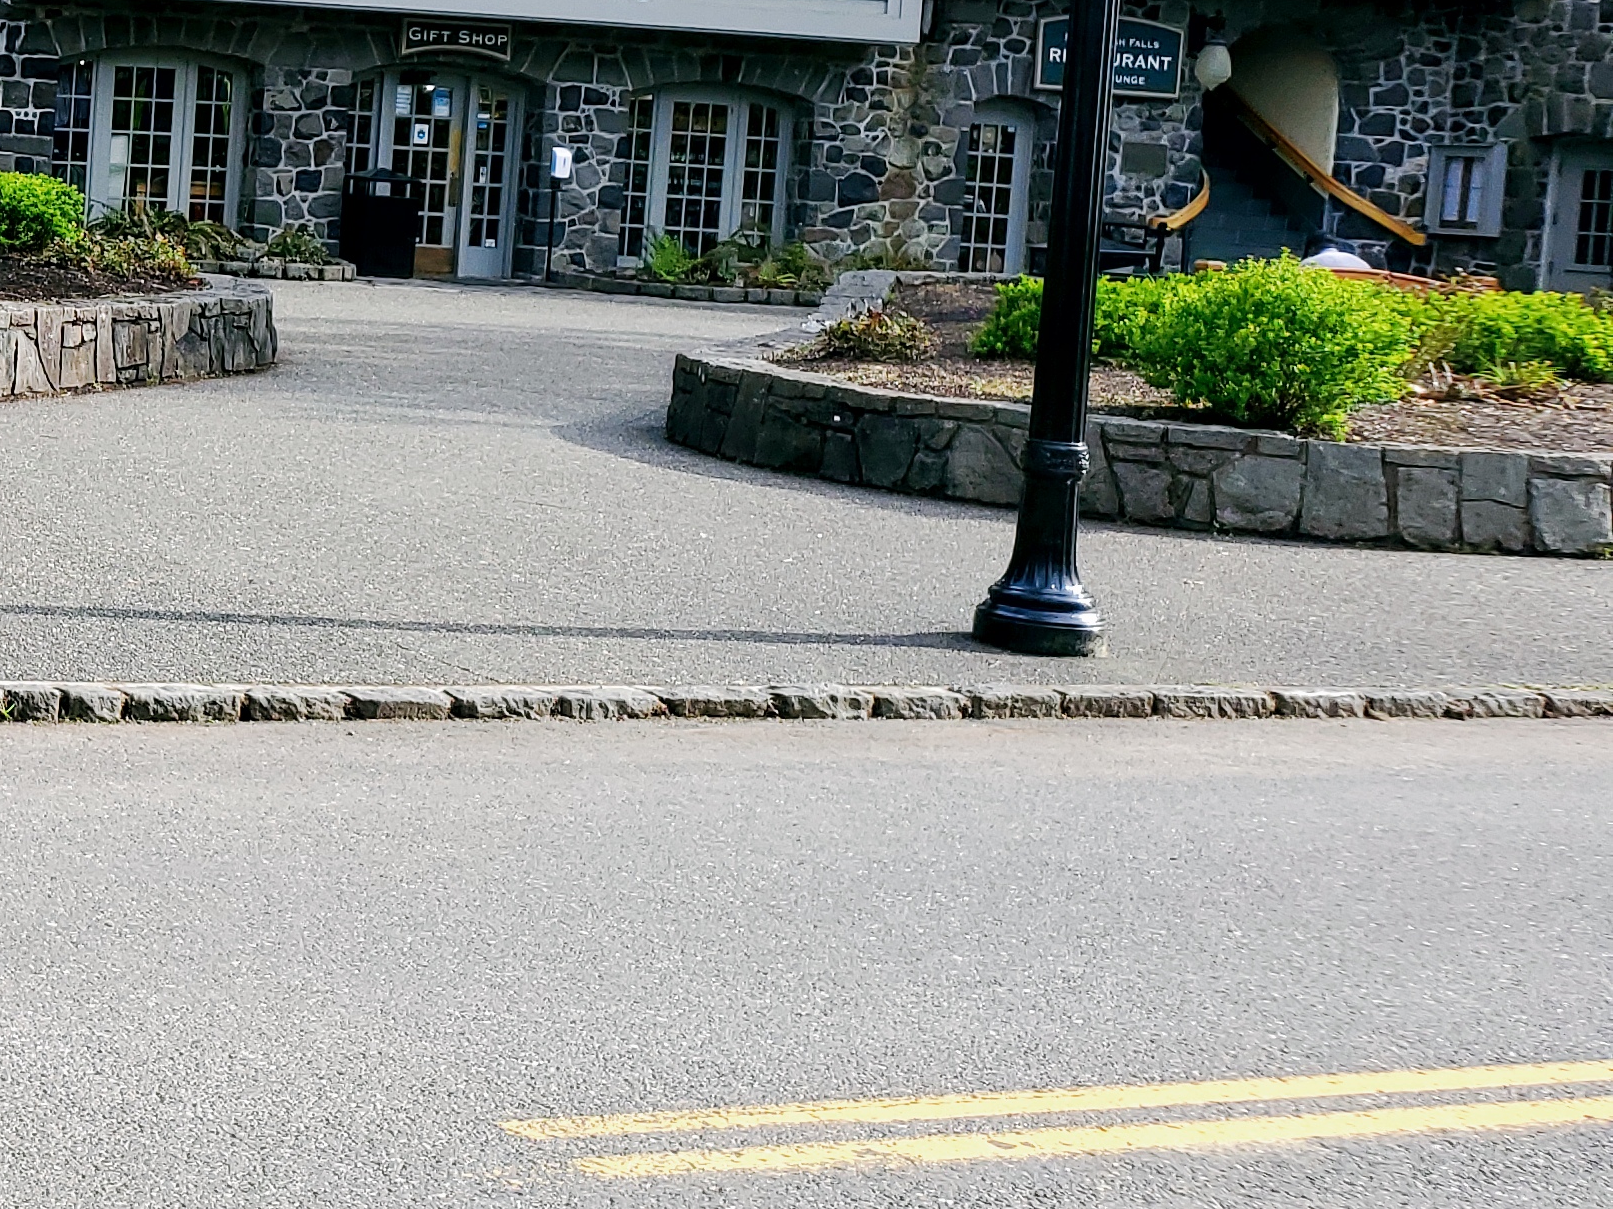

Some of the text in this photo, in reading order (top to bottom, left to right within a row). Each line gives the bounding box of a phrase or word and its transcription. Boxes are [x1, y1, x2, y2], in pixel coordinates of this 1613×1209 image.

[408, 27, 508, 46] GIFT SHOP
[1129, 38, 1160, 49] FALLS
